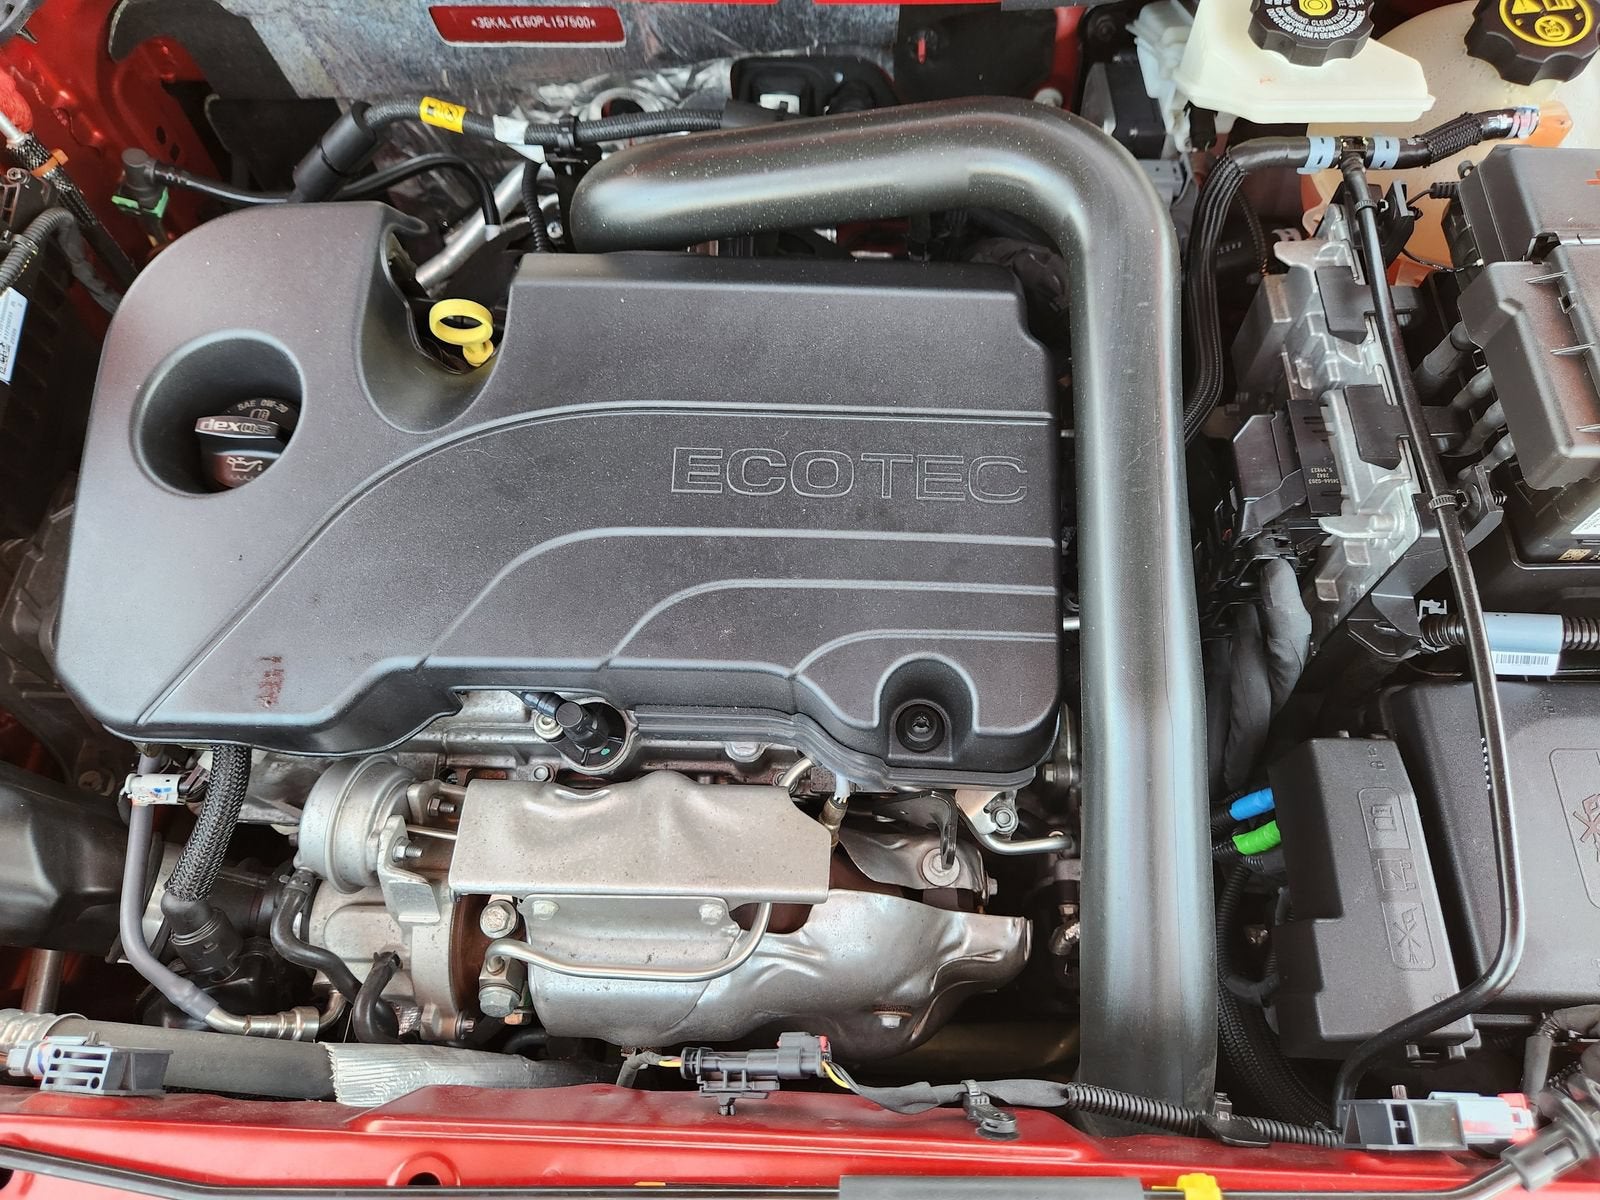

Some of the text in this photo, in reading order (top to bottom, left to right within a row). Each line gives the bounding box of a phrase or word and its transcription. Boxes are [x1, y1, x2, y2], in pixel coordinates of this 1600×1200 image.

[1275, 19, 1294, 32] FLUID
[1292, 27, 1313, 39] FROM
[1313, 32, 1319, 40] A
[1319, 29, 1345, 40] SEALED
[1282, 15, 1306, 31] BEFORE
[1311, 18, 1333, 27] CLEAN
[237, 399, 257, 411] SAE
[200, 418, 272, 435] dexos
[671, 447, 1028, 504] ECOTEC
